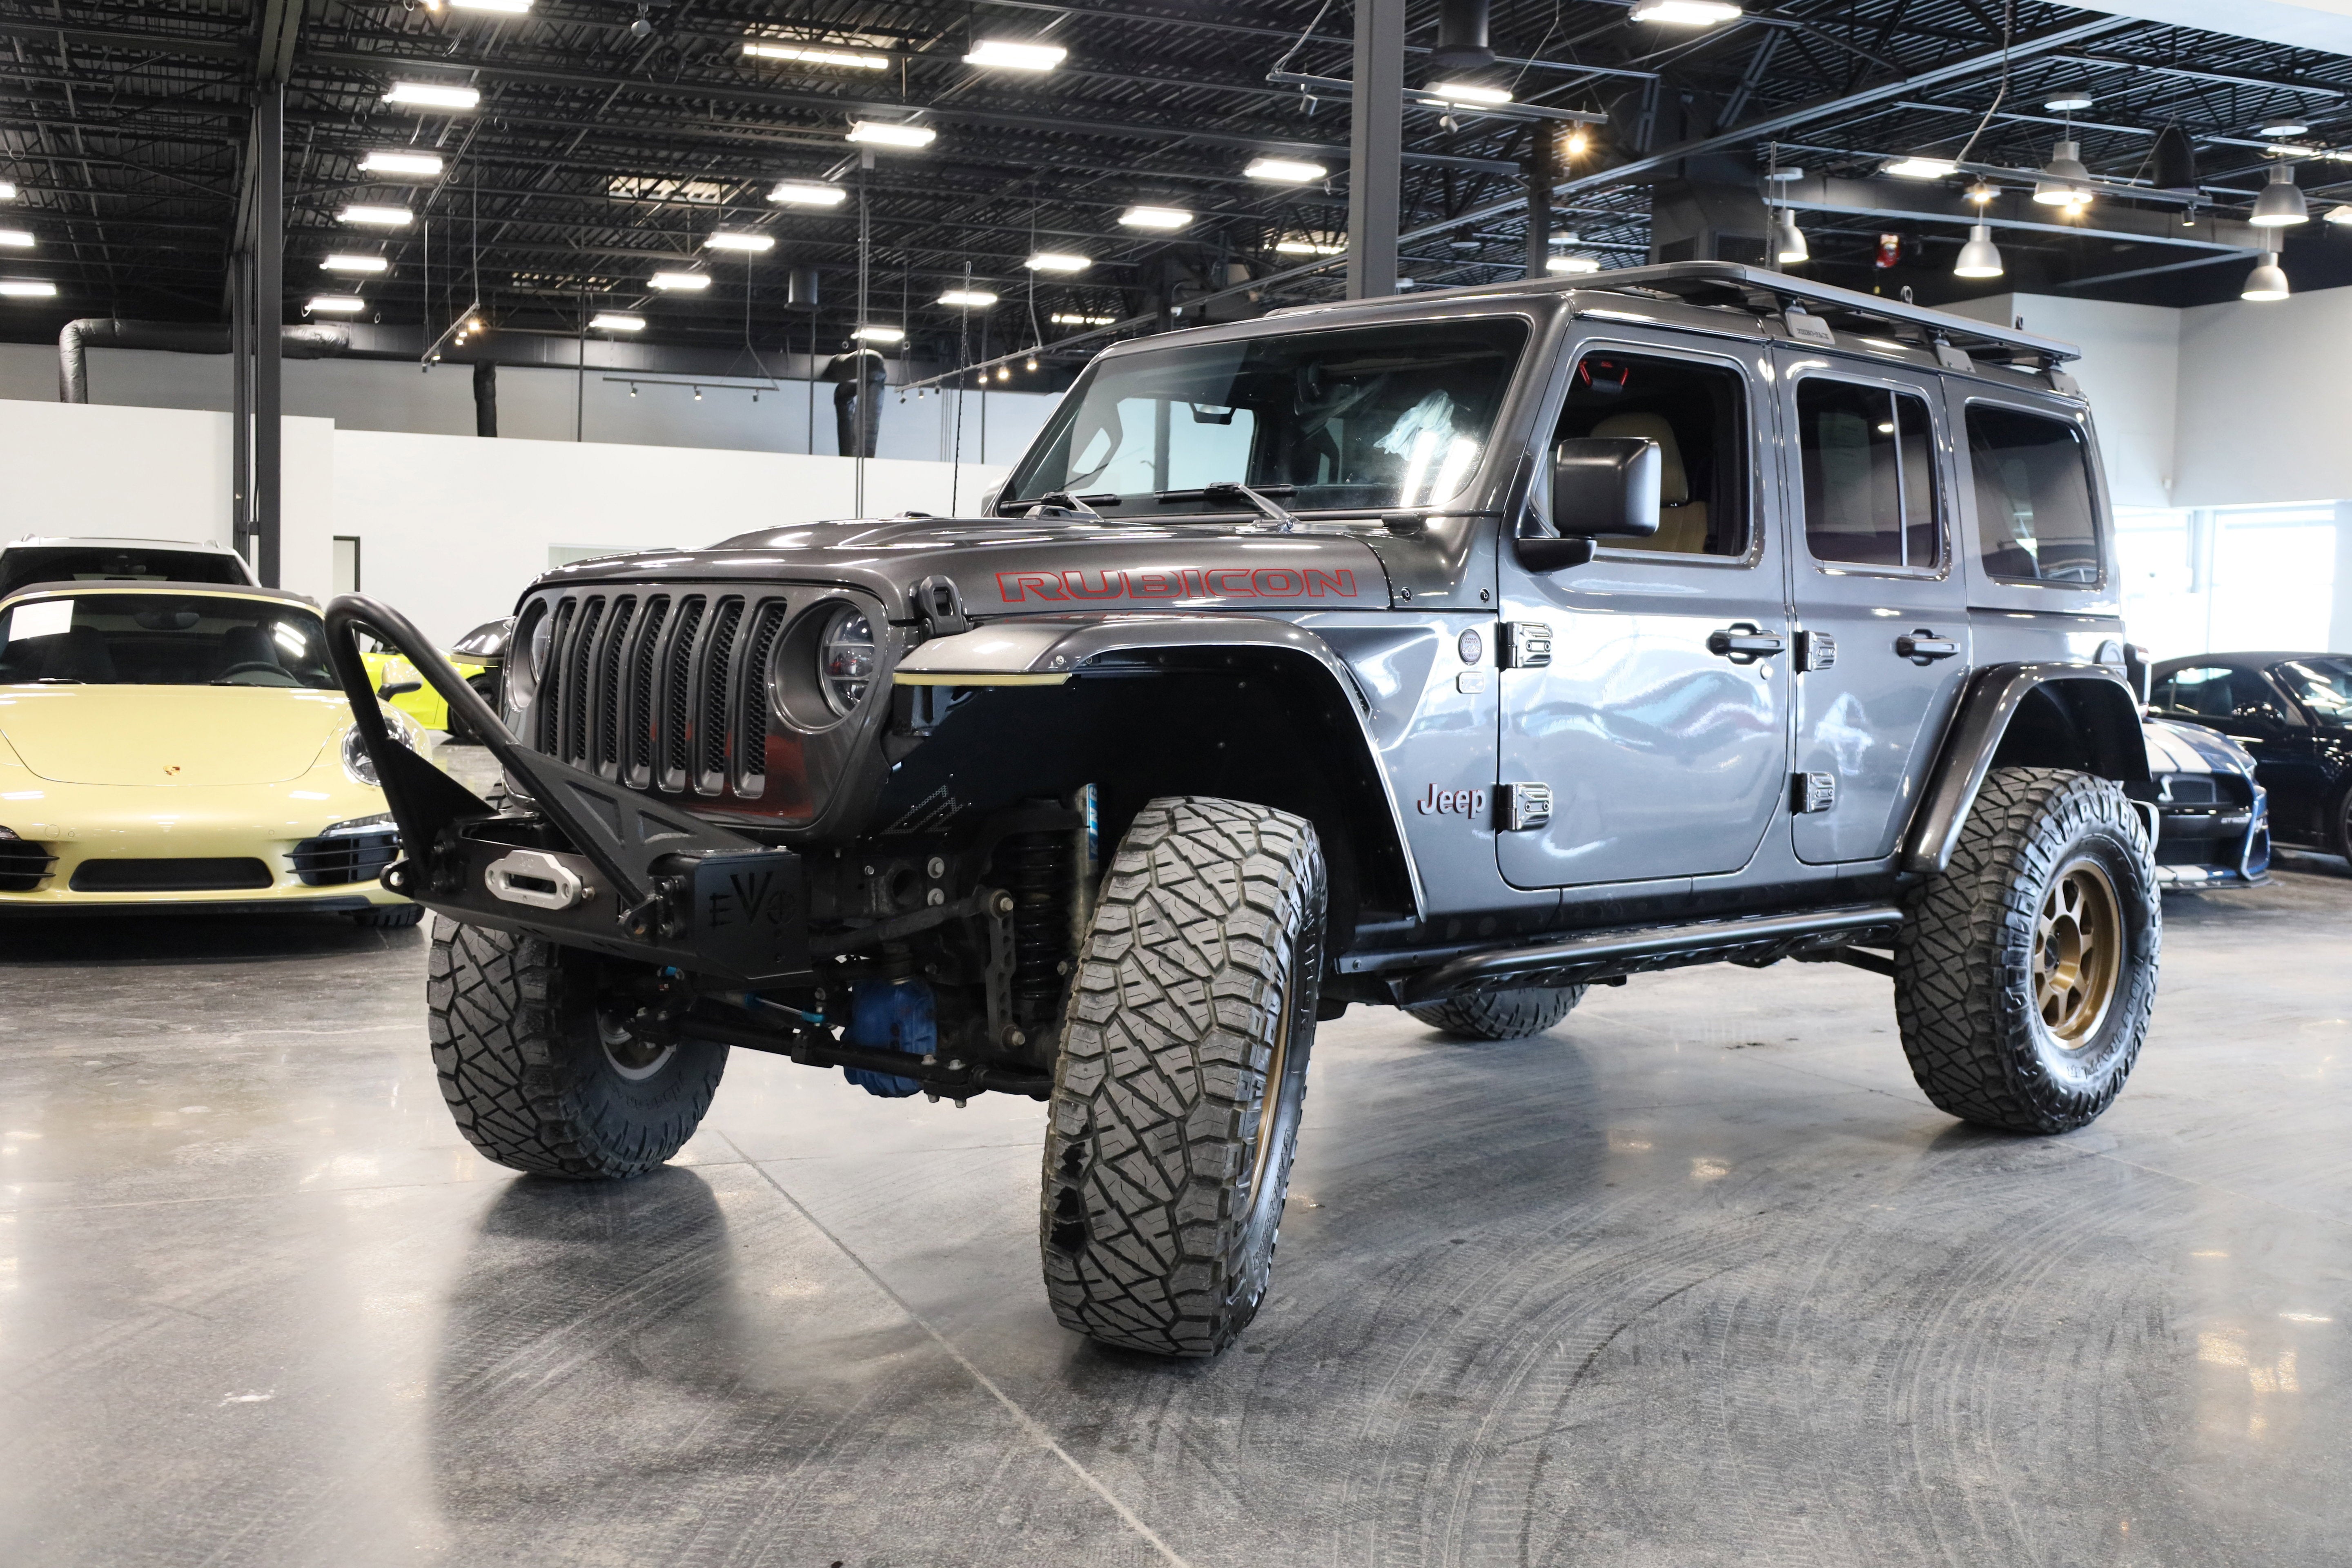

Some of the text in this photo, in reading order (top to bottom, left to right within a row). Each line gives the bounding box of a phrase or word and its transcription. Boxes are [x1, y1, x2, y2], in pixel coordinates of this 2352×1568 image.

[995, 568, 1357, 602] RUBICON
[1417, 783, 1486, 819] Jeep
[1089, 786, 1098, 855] KING
